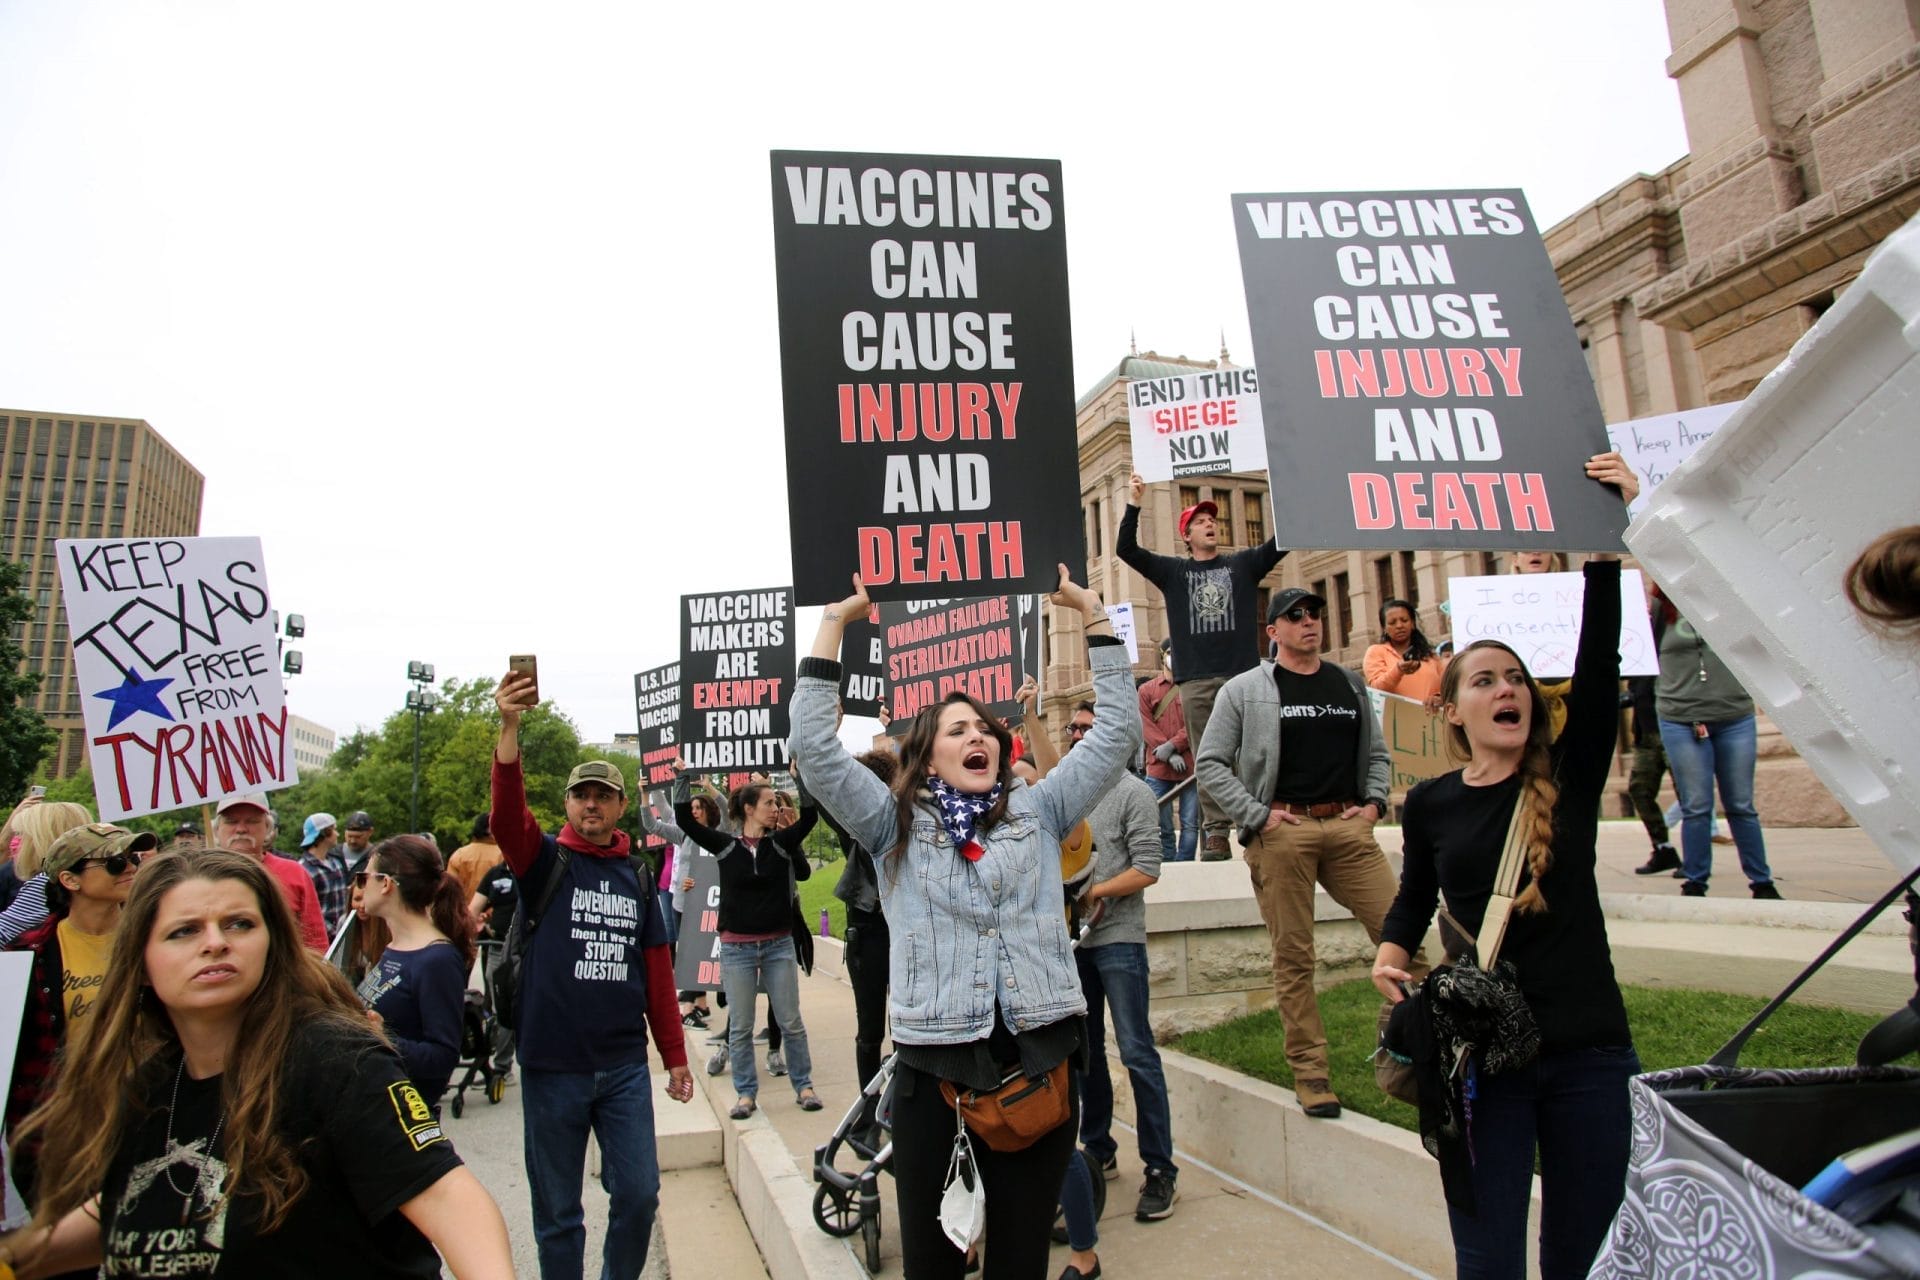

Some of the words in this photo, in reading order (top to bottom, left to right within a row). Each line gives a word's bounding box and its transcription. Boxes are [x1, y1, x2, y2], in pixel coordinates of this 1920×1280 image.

[784, 166, 1052, 230] VACCINES
[1246, 197, 1524, 239] VACCINES
[870, 239, 978, 299] CAN
[1336, 244, 1456, 286] CAN
[1313, 293, 1510, 341] CAUSE
[842, 310, 1016, 371] CAUSE
[1133, 377, 1185, 408] END
[1199, 368, 1258, 399] THIS
[1314, 347, 1523, 398] INJURY
[837, 382, 1023, 443] INJURY
[1155, 400, 1238, 434] SIEGE
[1168, 430, 1229, 463] NOW
[1374, 408, 1503, 462] AND
[883, 453, 992, 514] AND
[1173, 461, 1231, 477] INFOWARS.COM
[1347, 472, 1555, 532] DEATH
[70, 541, 186, 592] KEEP
[857, 520, 1025, 586] DEATH
[688, 591, 787, 624] VACCINE
[1476, 588, 1501, 606] I
[74, 560, 269, 687] TEXAS
[690, 620, 785, 652] MAKERS
[887, 611, 947, 649] OVARIAN
[949, 595, 1010, 633] FAILURE
[183, 644, 268, 686] FREE
[715, 651, 759, 680] ARE
[889, 626, 1012, 682] STERILIZATION
[176, 684, 260, 720] FROM
[640, 672, 660, 692] U.S.
[693, 677, 782, 710] EXEMPT
[893, 679, 935, 721] AND
[639, 703, 680, 730] VACCIN
[659, 726, 674, 746] AS
[705, 708, 771, 738] FROM
[93, 705, 288, 812] TYRANNY
[684, 738, 791, 769] LIABILITY
[571, 887, 638, 920] GOVERNMENT
[571, 911, 581, 922] is
[584, 911, 601, 924] the
[571, 928, 597, 941] then
[599, 930, 608, 941] it
[629, 936, 636, 946] a
[584, 941, 625, 962] STUPID
[574, 960, 629, 982] QUESTION
